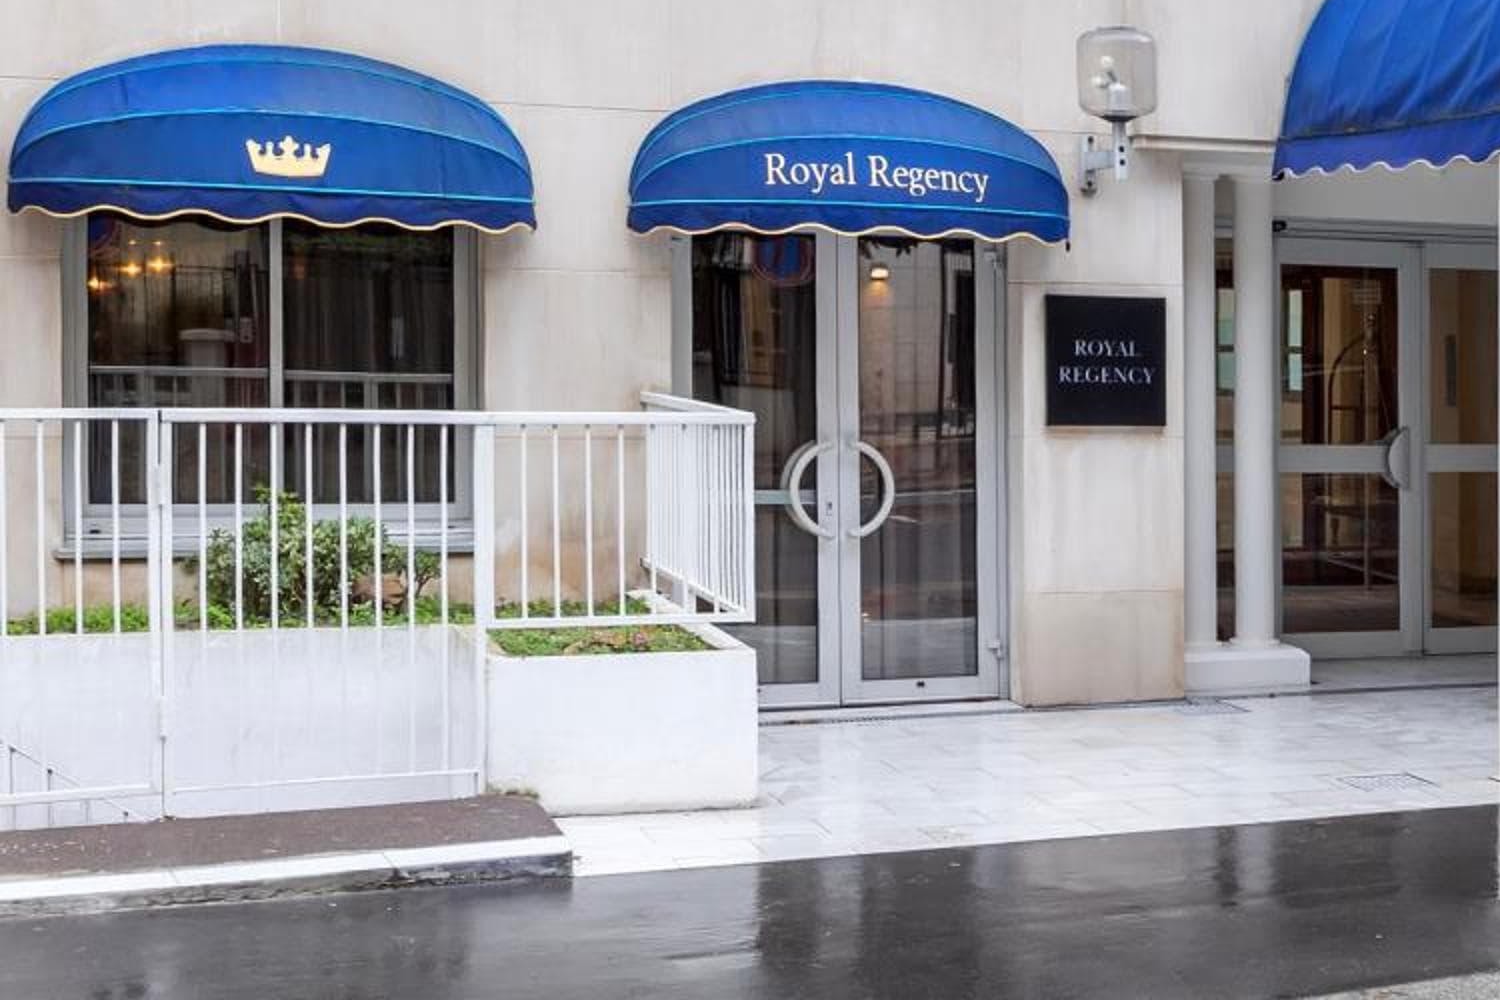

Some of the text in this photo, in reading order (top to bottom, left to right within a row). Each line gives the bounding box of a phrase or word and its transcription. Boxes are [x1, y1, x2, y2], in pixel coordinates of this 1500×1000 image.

[764, 151, 989, 203] Royal Regency
[1074, 339, 1142, 357] ROYAL
[1059, 366, 1156, 384] REGENCY
